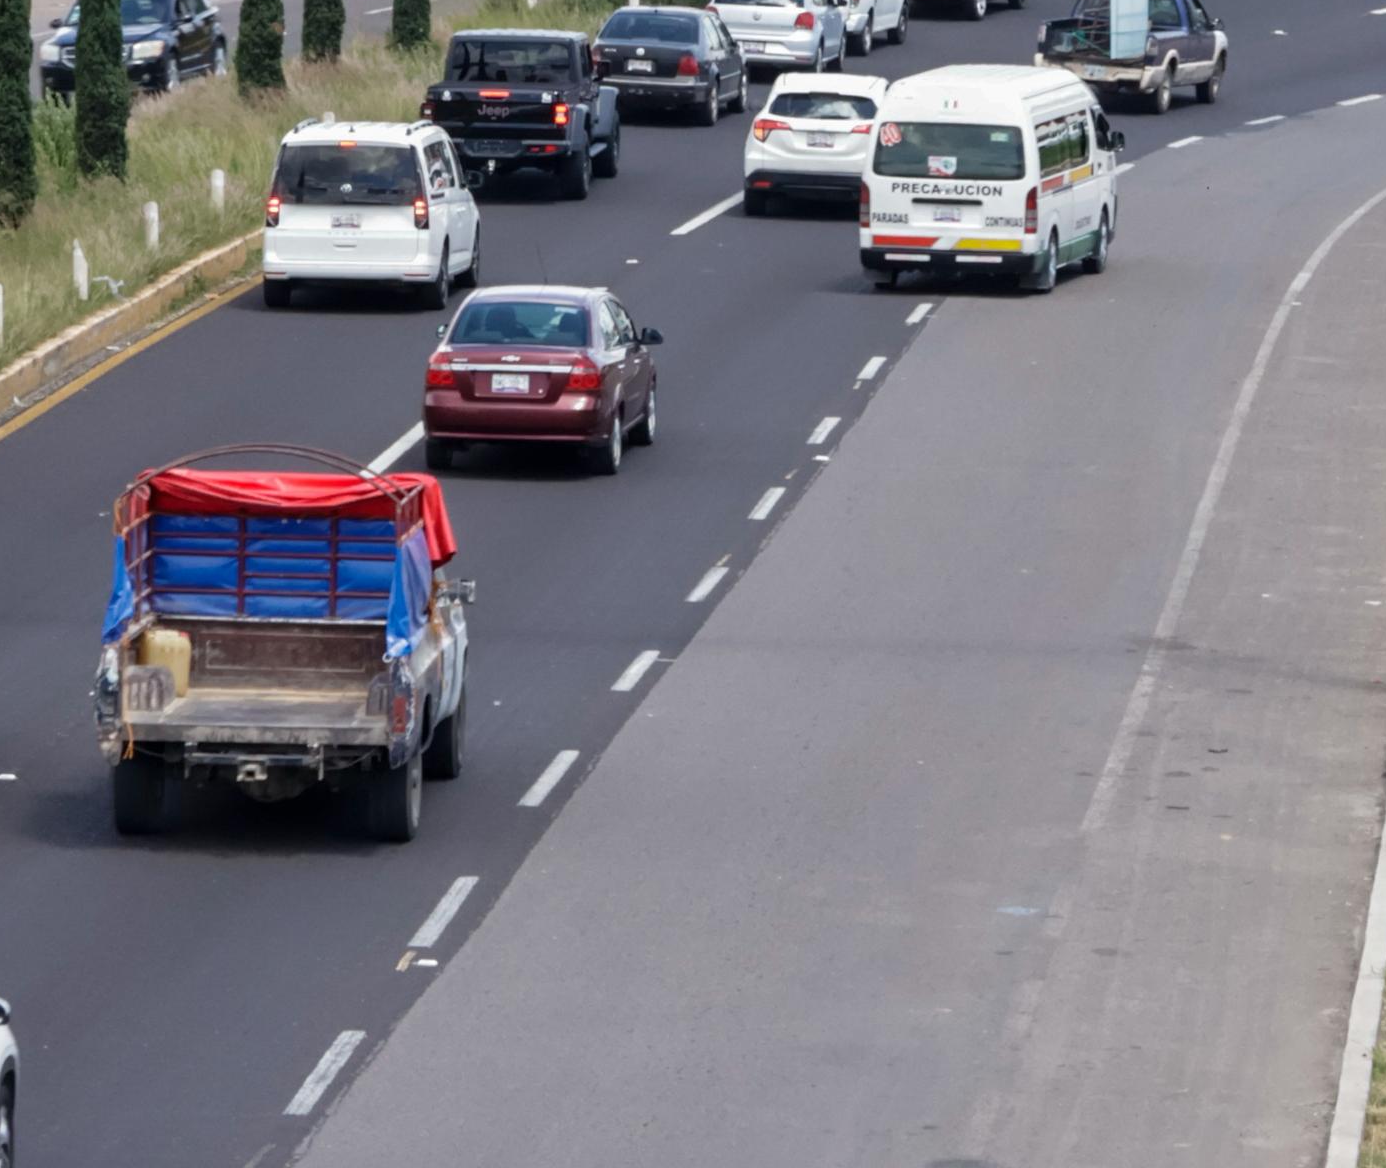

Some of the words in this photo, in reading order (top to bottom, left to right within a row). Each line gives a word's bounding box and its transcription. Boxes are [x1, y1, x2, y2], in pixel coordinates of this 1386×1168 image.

[477, 104, 510, 119] Jeep
[872, 212, 909, 225] PARADAS
[985, 216, 1024, 228] CONTINUAS
